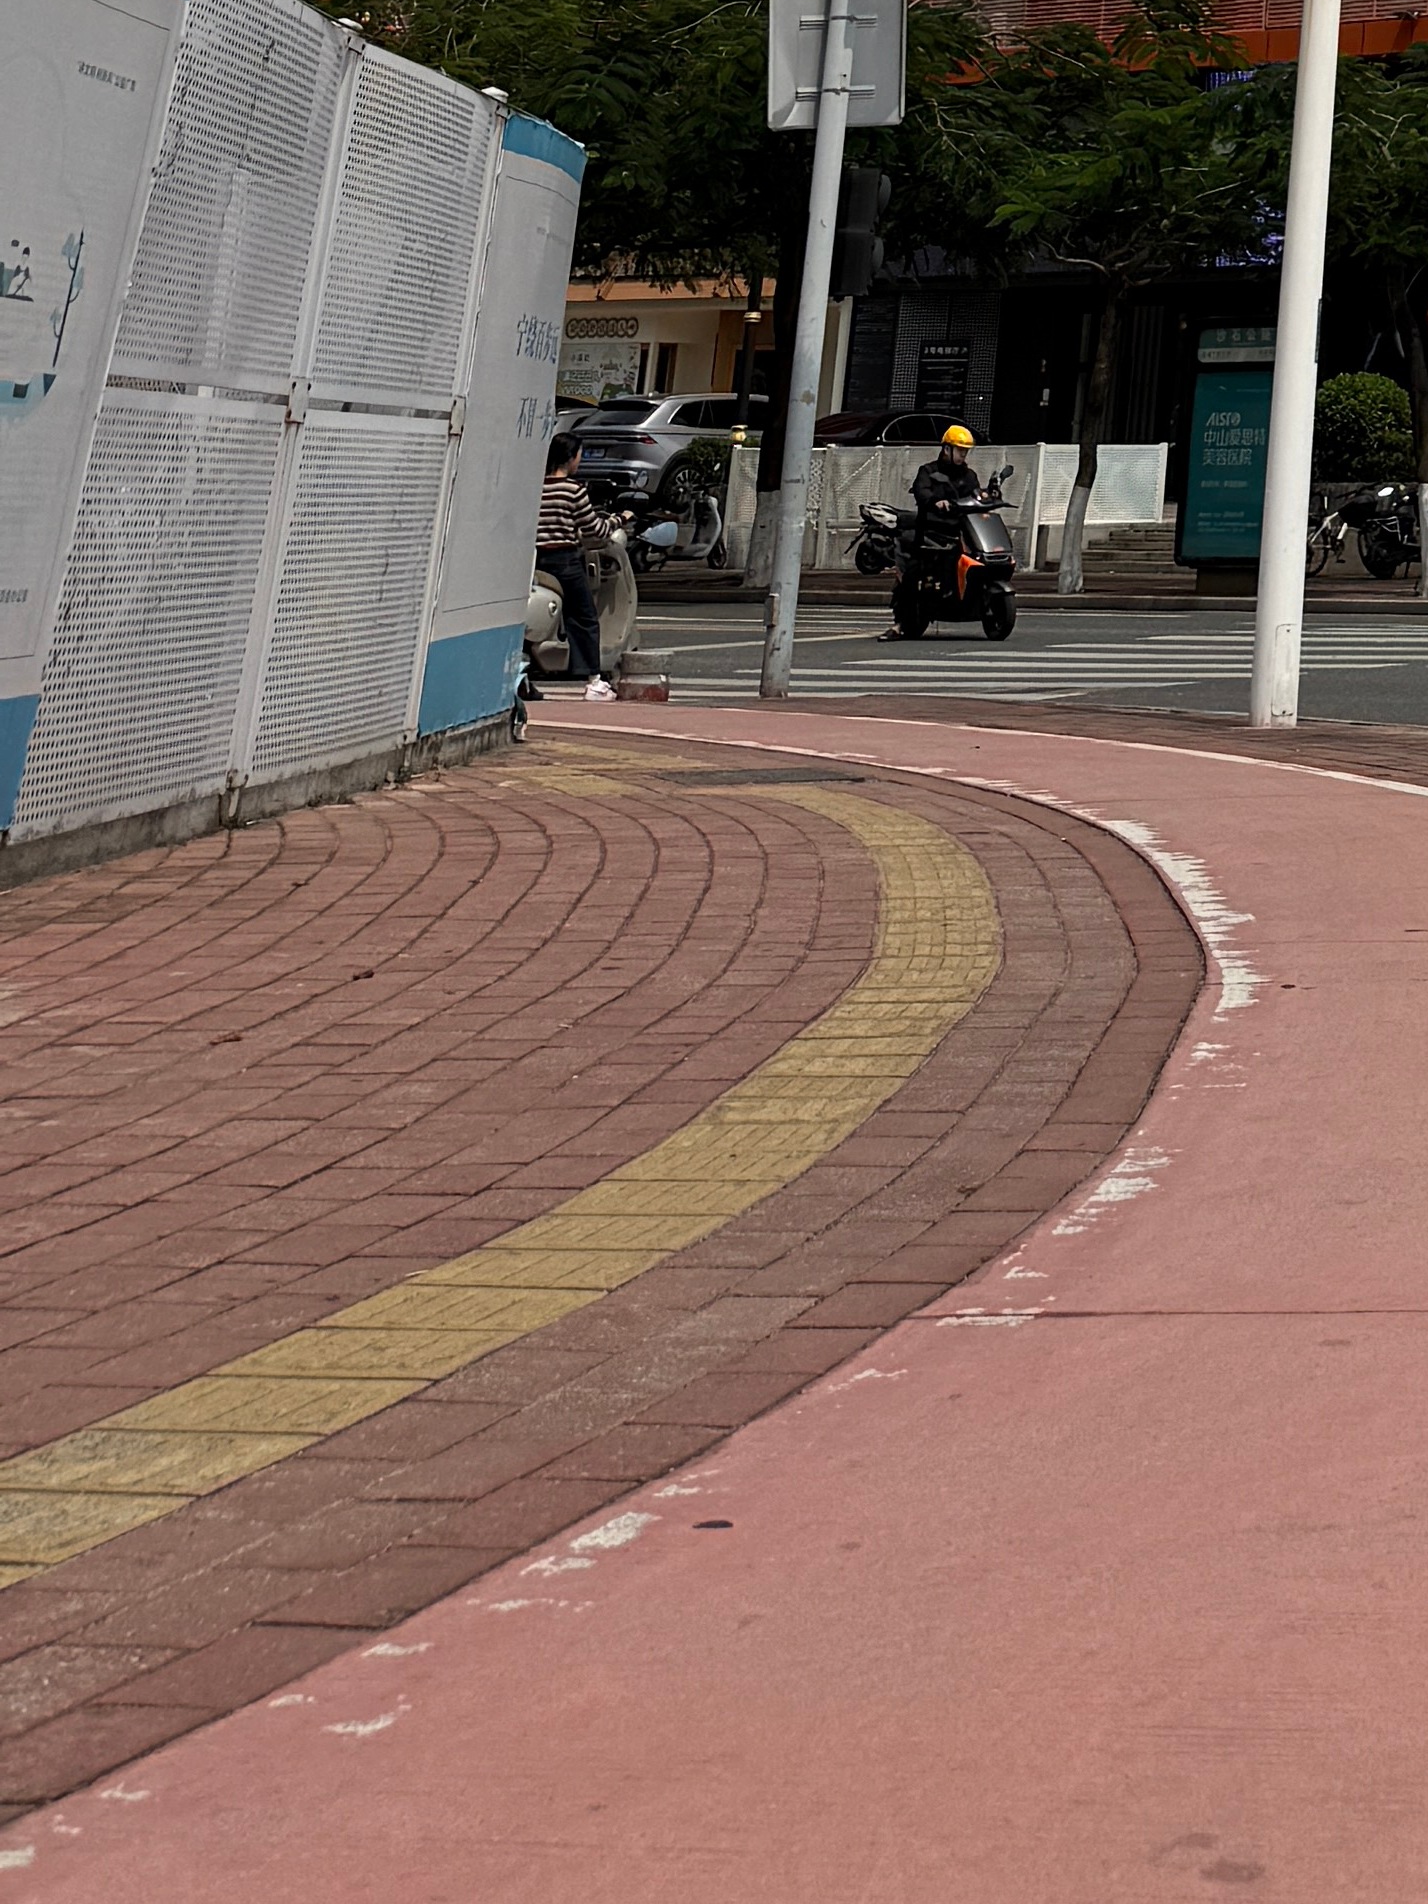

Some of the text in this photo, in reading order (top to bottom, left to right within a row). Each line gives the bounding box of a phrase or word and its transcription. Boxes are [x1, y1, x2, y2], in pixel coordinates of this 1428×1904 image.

[1204, 428, 1265, 446] 中山爱思特
[1203, 448, 1252, 466] 美容医院
